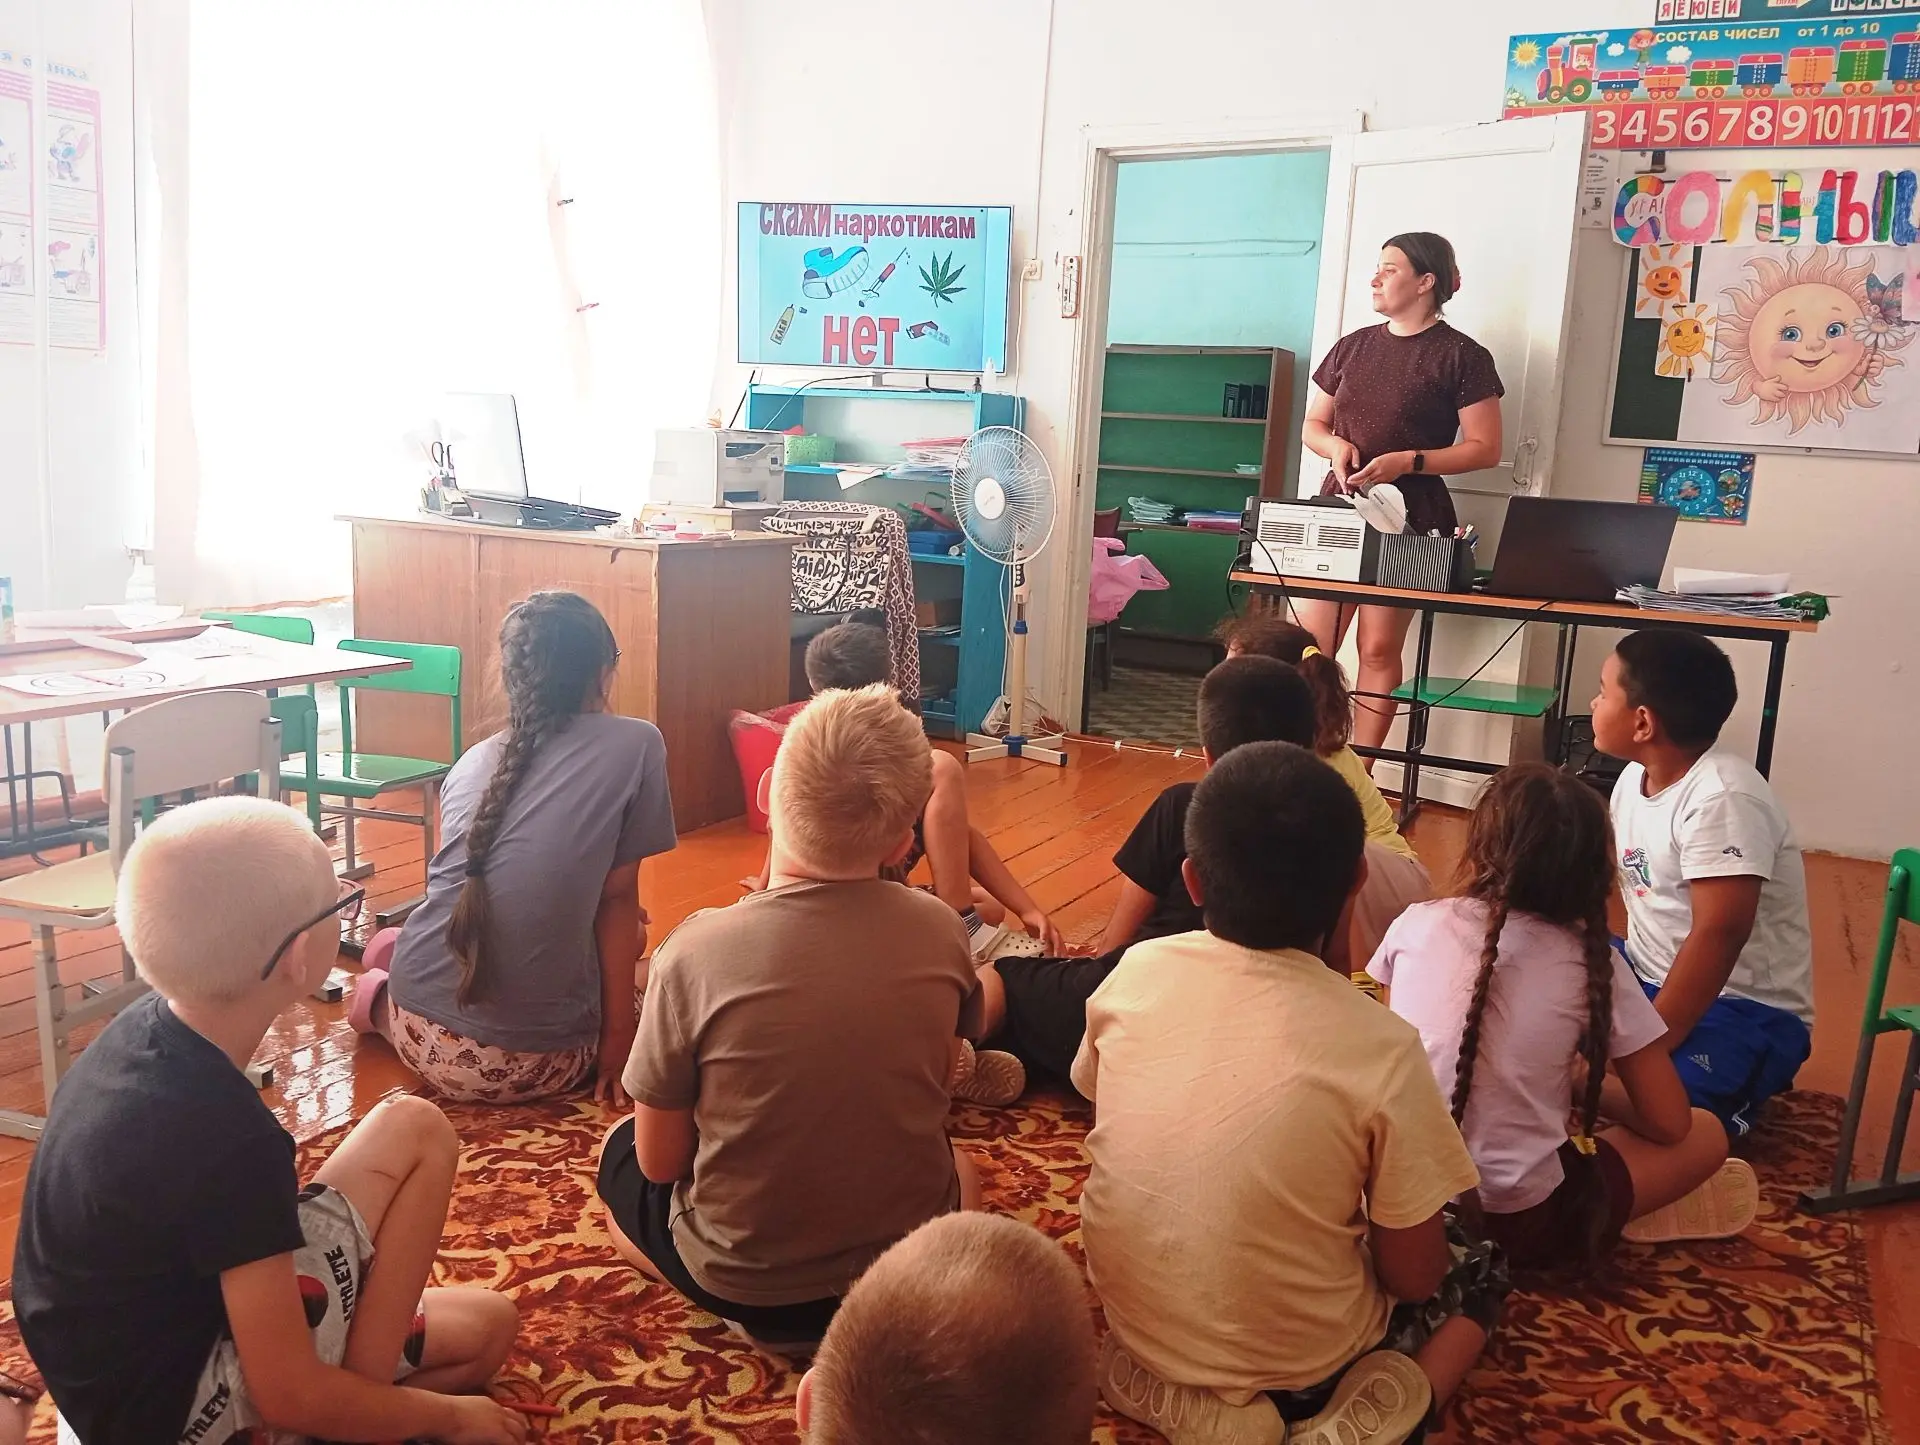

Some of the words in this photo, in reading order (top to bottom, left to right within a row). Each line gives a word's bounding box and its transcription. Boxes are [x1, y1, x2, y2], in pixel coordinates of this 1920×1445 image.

[1656, 30, 1719, 43] СОСТАВ
[1724, 27, 1780, 40] ЧИСЕЛ
[1797, 28, 1815, 37] от
[1821, 24, 1829, 37] 1
[1834, 26, 1855, 38] до
[1861, 22, 1880, 34] 10
[1592, 110, 1616, 144] 3
[1622, 110, 1648, 143] 4
[1653, 108, 1678, 142] 5
[1684, 107, 1710, 142] 6
[1718, 107, 1742, 141] 7
[1747, 105, 1774, 141] 8
[1782, 105, 1807, 141] 9
[1813, 104, 1843, 140] 10
[1847, 104, 1876, 140] 11
[1881, 103, 1913, 139] 12
[834, 212, 976, 243] наркотикам
